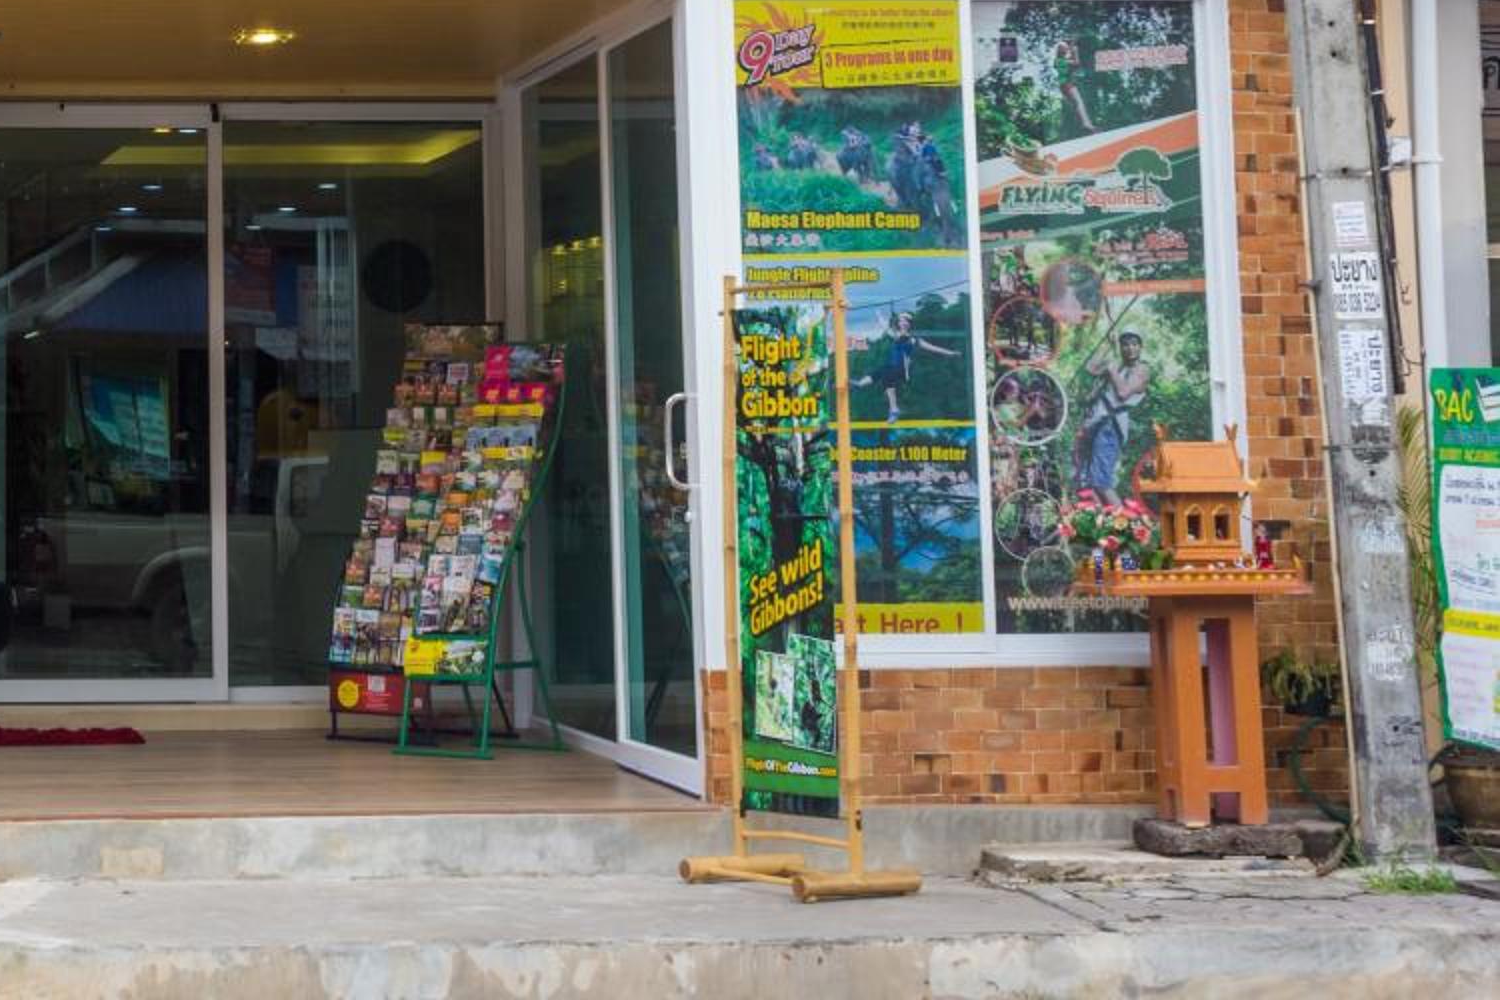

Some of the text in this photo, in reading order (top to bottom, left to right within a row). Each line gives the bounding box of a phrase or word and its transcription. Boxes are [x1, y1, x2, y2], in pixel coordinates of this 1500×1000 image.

[746, 210, 921, 231] Maesa Elephant Camp
[741, 333, 801, 365] Flight
[742, 367, 787, 387] of the
[742, 388, 818, 418] Gibbon
[750, 537, 822, 605] See wild
[750, 570, 824, 636] Gibbons!
[879, 611, 941, 634] Here
